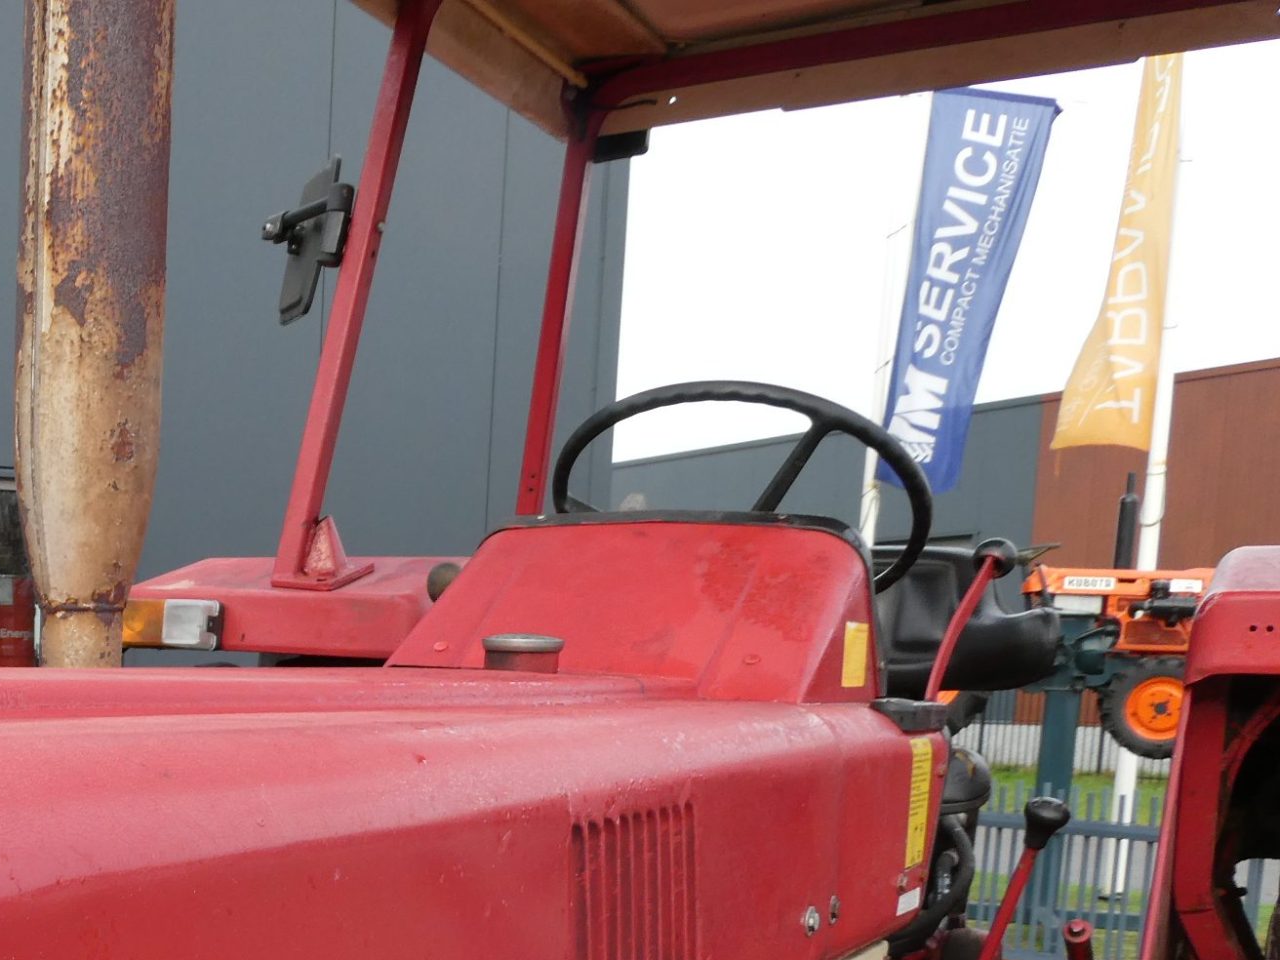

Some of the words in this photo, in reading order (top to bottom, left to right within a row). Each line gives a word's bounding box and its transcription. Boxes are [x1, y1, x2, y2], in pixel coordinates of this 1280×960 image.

[913, 108, 1008, 359] SERVICE
[940, 267, 980, 366] COMPACT
[970, 116, 1030, 265] MECHANISATIE
